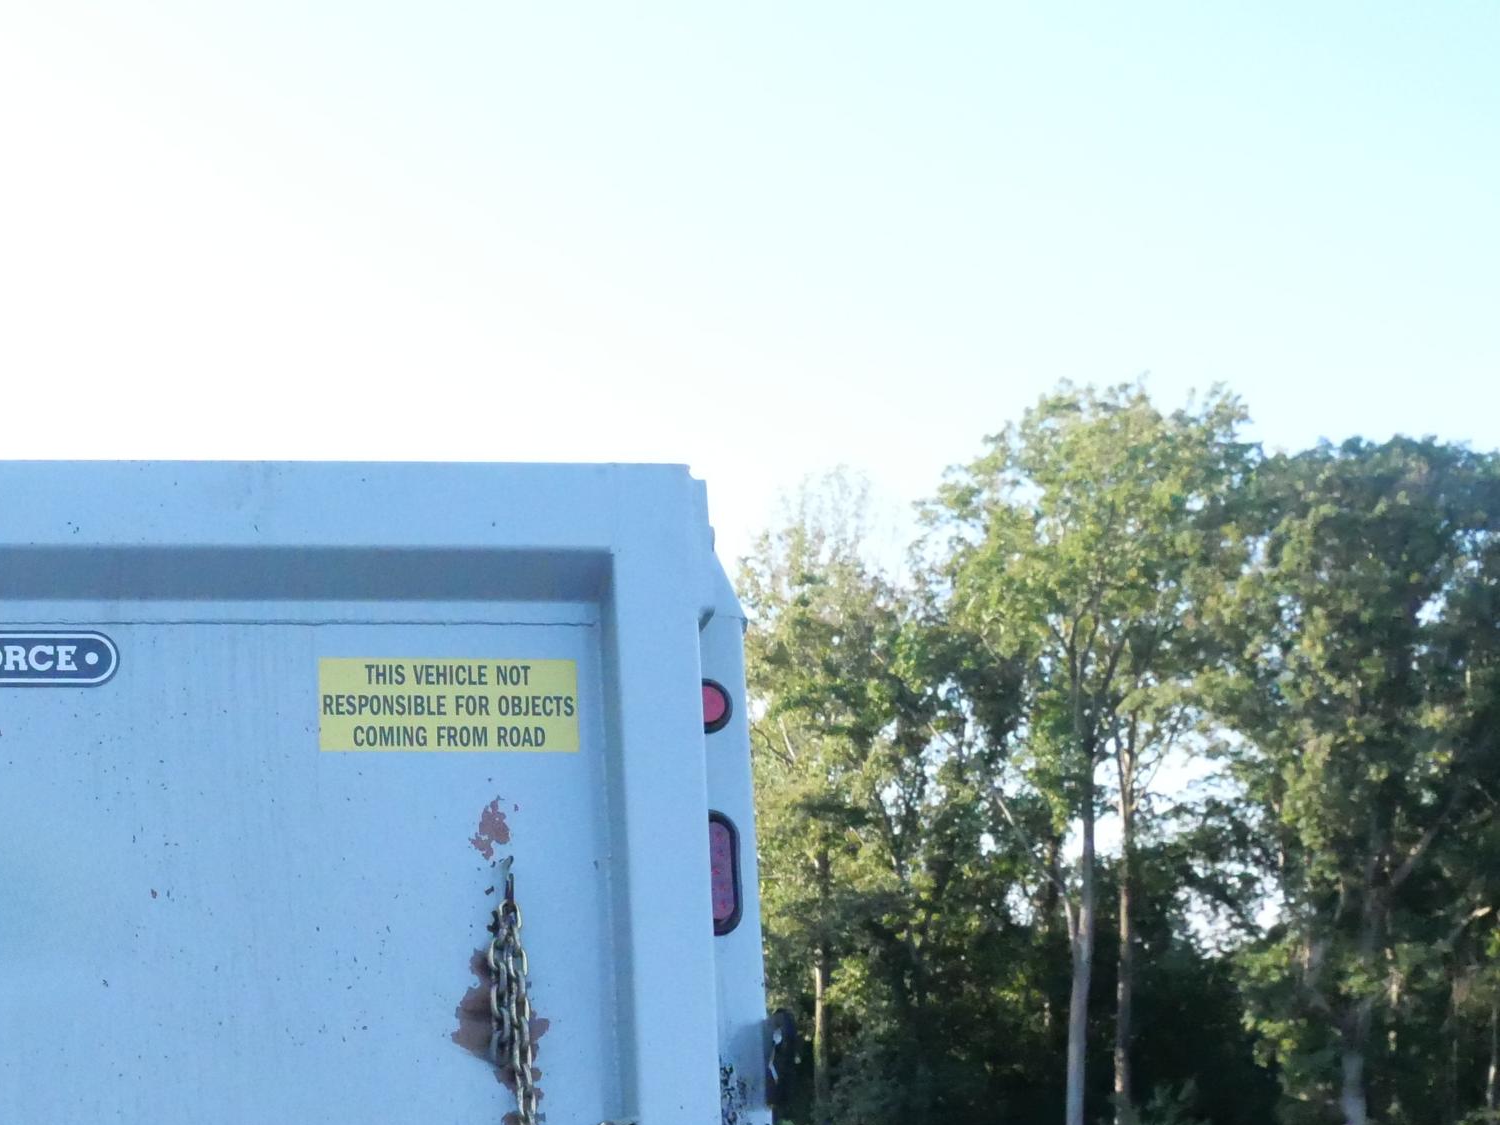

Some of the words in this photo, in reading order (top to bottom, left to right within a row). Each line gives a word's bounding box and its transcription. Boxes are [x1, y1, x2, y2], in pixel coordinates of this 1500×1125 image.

[364, 664, 406, 685] THIS
[413, 664, 488, 686] VEHICLE
[496, 665, 531, 686] NOT
[323, 694, 447, 716] RESPONSIBLE
[455, 695, 490, 716] FOR
[498, 695, 574, 717] OBJECTS
[353, 725, 428, 747] COMING
[436, 726, 488, 747] FROM
[497, 726, 546, 747] ROAD
